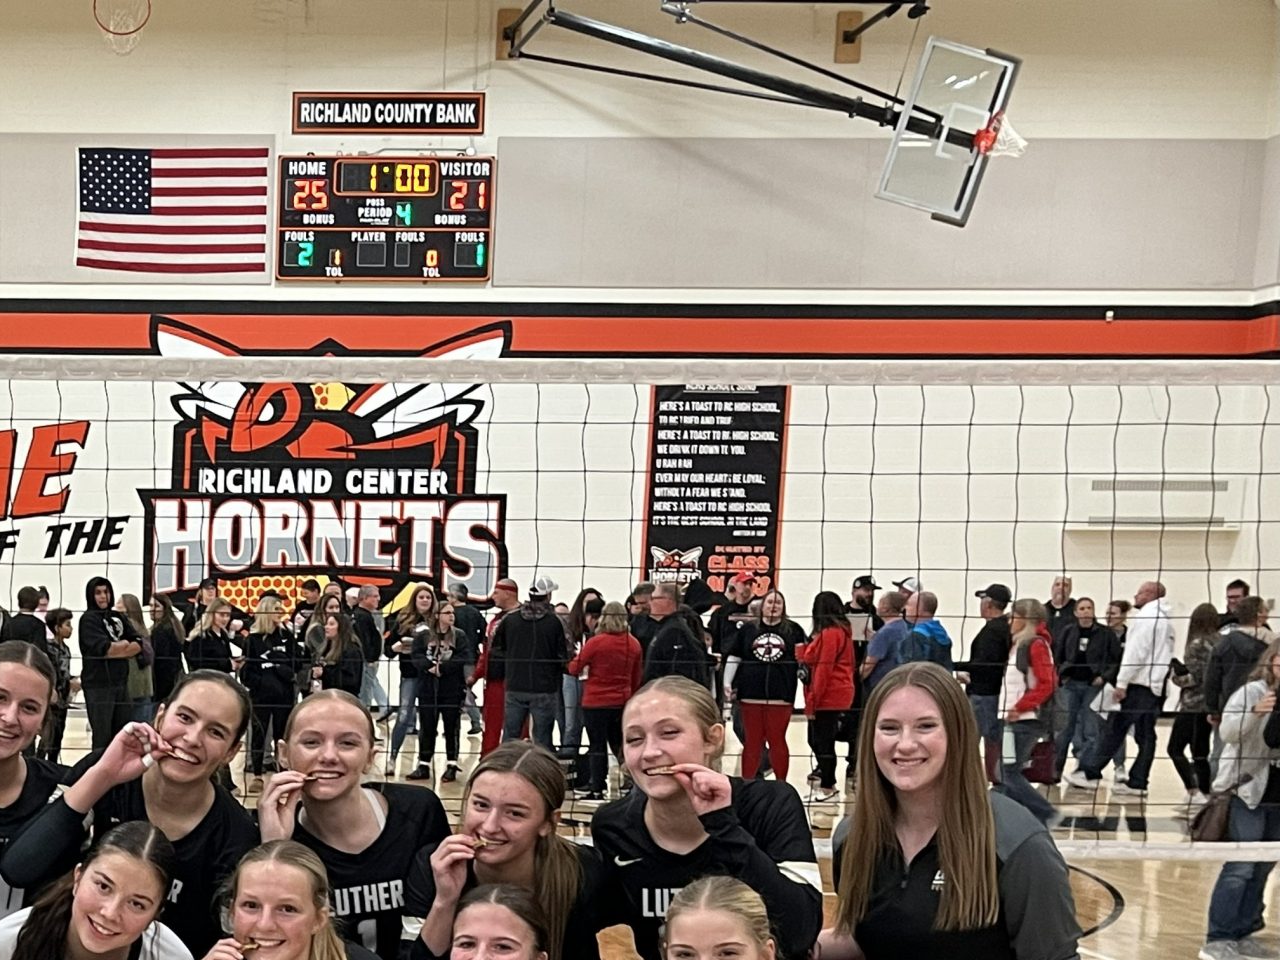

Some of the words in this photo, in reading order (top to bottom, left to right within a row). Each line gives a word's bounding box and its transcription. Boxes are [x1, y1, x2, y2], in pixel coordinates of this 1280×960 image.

[301, 103, 371, 123] RICHLAND
[375, 104, 432, 123] COUNTY
[436, 104, 476, 123] BANK
[289, 161, 326, 175] HOME
[440, 162, 490, 176] VISITOR
[293, 180, 328, 210] 25
[450, 182, 485, 210] 21
[366, 199, 384, 207] POSS
[358, 207, 393, 218] PERIOD
[396, 203, 411, 225] 4
[303, 214, 335, 225] BONUS
[434, 214, 466, 225] BONUS
[285, 232, 314, 241] FOULS
[351, 232, 386, 242] PLAYER
[396, 232, 425, 242] FOULS
[455, 232, 485, 242] FOULS
[298, 243, 313, 266] 2
[426, 250, 438, 266] 0
[325, 267, 343, 277] TOL
[423, 268, 440, 277] TOL
[685, 402, 690, 411] A
[691, 402, 713, 411] TOAST
[714, 402, 723, 411] TO
[734, 402, 751, 412] HIGH
[683, 430, 688, 440] A
[689, 430, 711, 440] TOAST
[712, 431, 721, 440] TO
[732, 431, 749, 440] HIGH
[657, 445, 668, 454] WE
[198, 468, 333, 494] RICHLAND
[345, 469, 448, 495] CENTER
[655, 473, 674, 483] EVER
[690, 474, 704, 483] OUR
[732, 474, 742, 483] BE
[685, 488, 691, 497] A
[692, 488, 710, 497] FEAR
[711, 488, 721, 497] WE
[653, 502, 678, 511] HERE'S
[685, 502, 706, 511] TOAST
[707, 502, 716, 511] TO
[728, 502, 744, 512] HIGH
[44, 515, 130, 559] THE
[150, 498, 502, 602] HORNETS
[707, 555, 770, 573] CLASS
